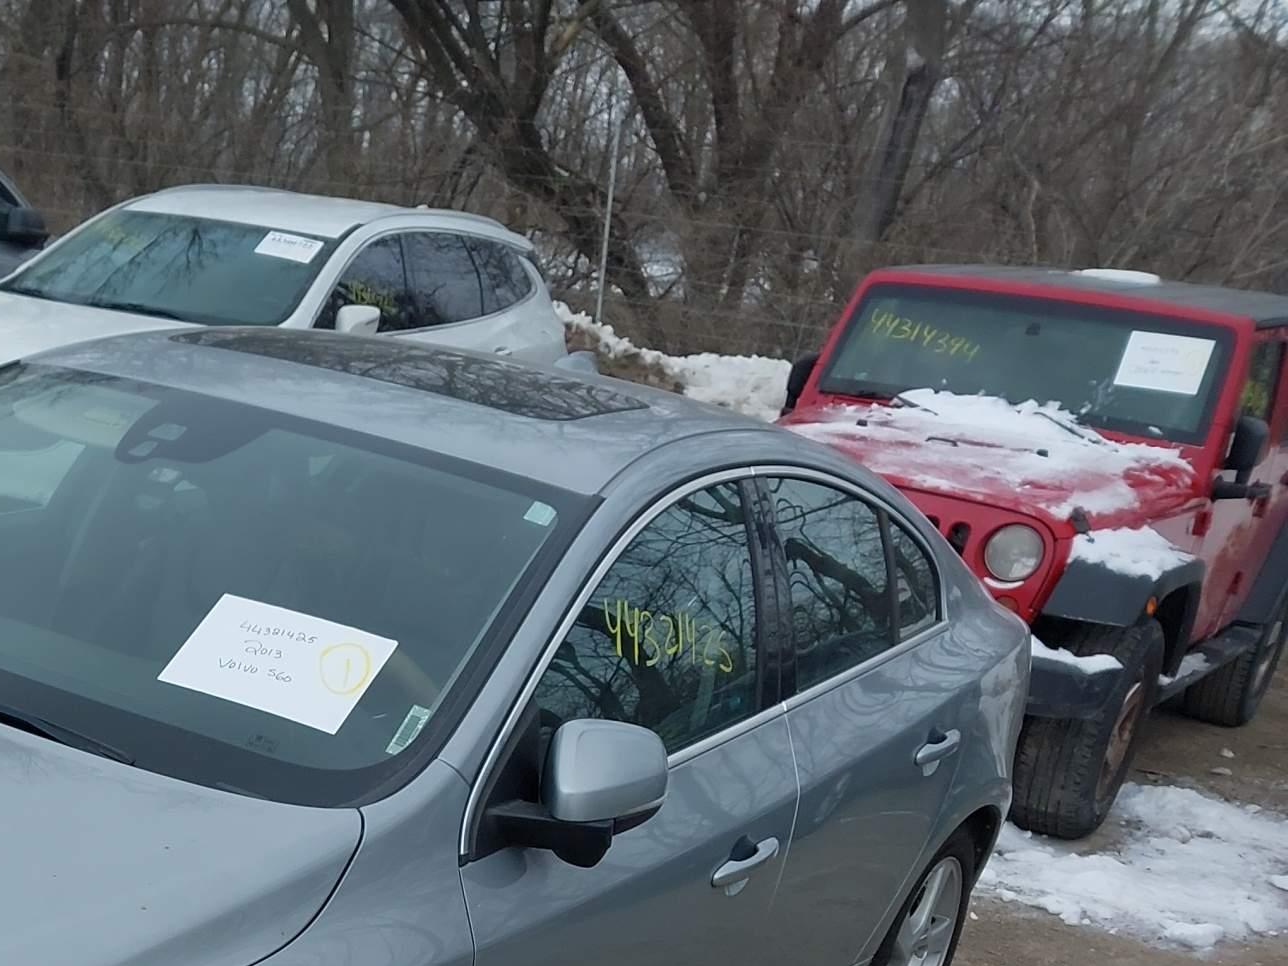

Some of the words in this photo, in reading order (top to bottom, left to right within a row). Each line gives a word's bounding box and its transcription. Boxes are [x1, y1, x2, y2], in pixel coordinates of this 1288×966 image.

[871, 307, 981, 364] 44314394
[244, 639, 282, 659] 2013
[604, 598, 733, 673] 44321425
